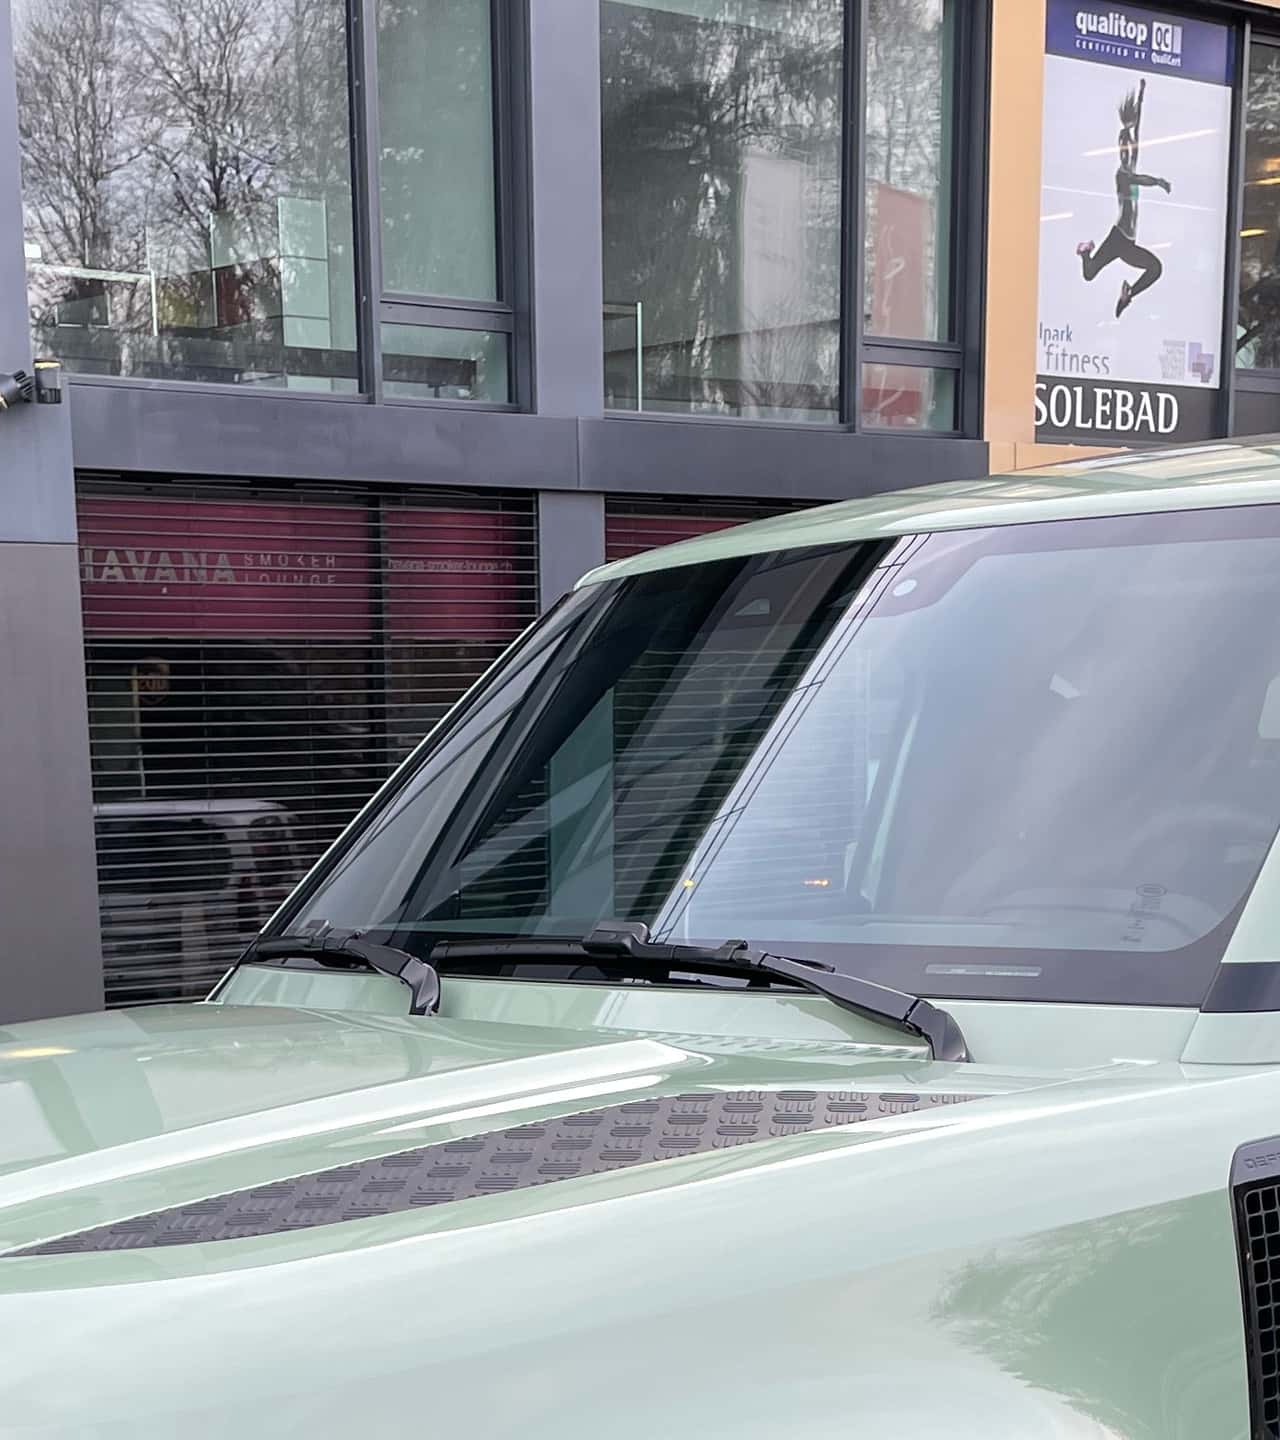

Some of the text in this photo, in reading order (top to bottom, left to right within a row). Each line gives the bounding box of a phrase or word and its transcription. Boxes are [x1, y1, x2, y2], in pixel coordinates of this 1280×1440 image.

[1075, 11, 1148, 45] qualitop
[1045, 343, 1111, 375] fitness
[1034, 382, 1179, 433] SOLEBAD
